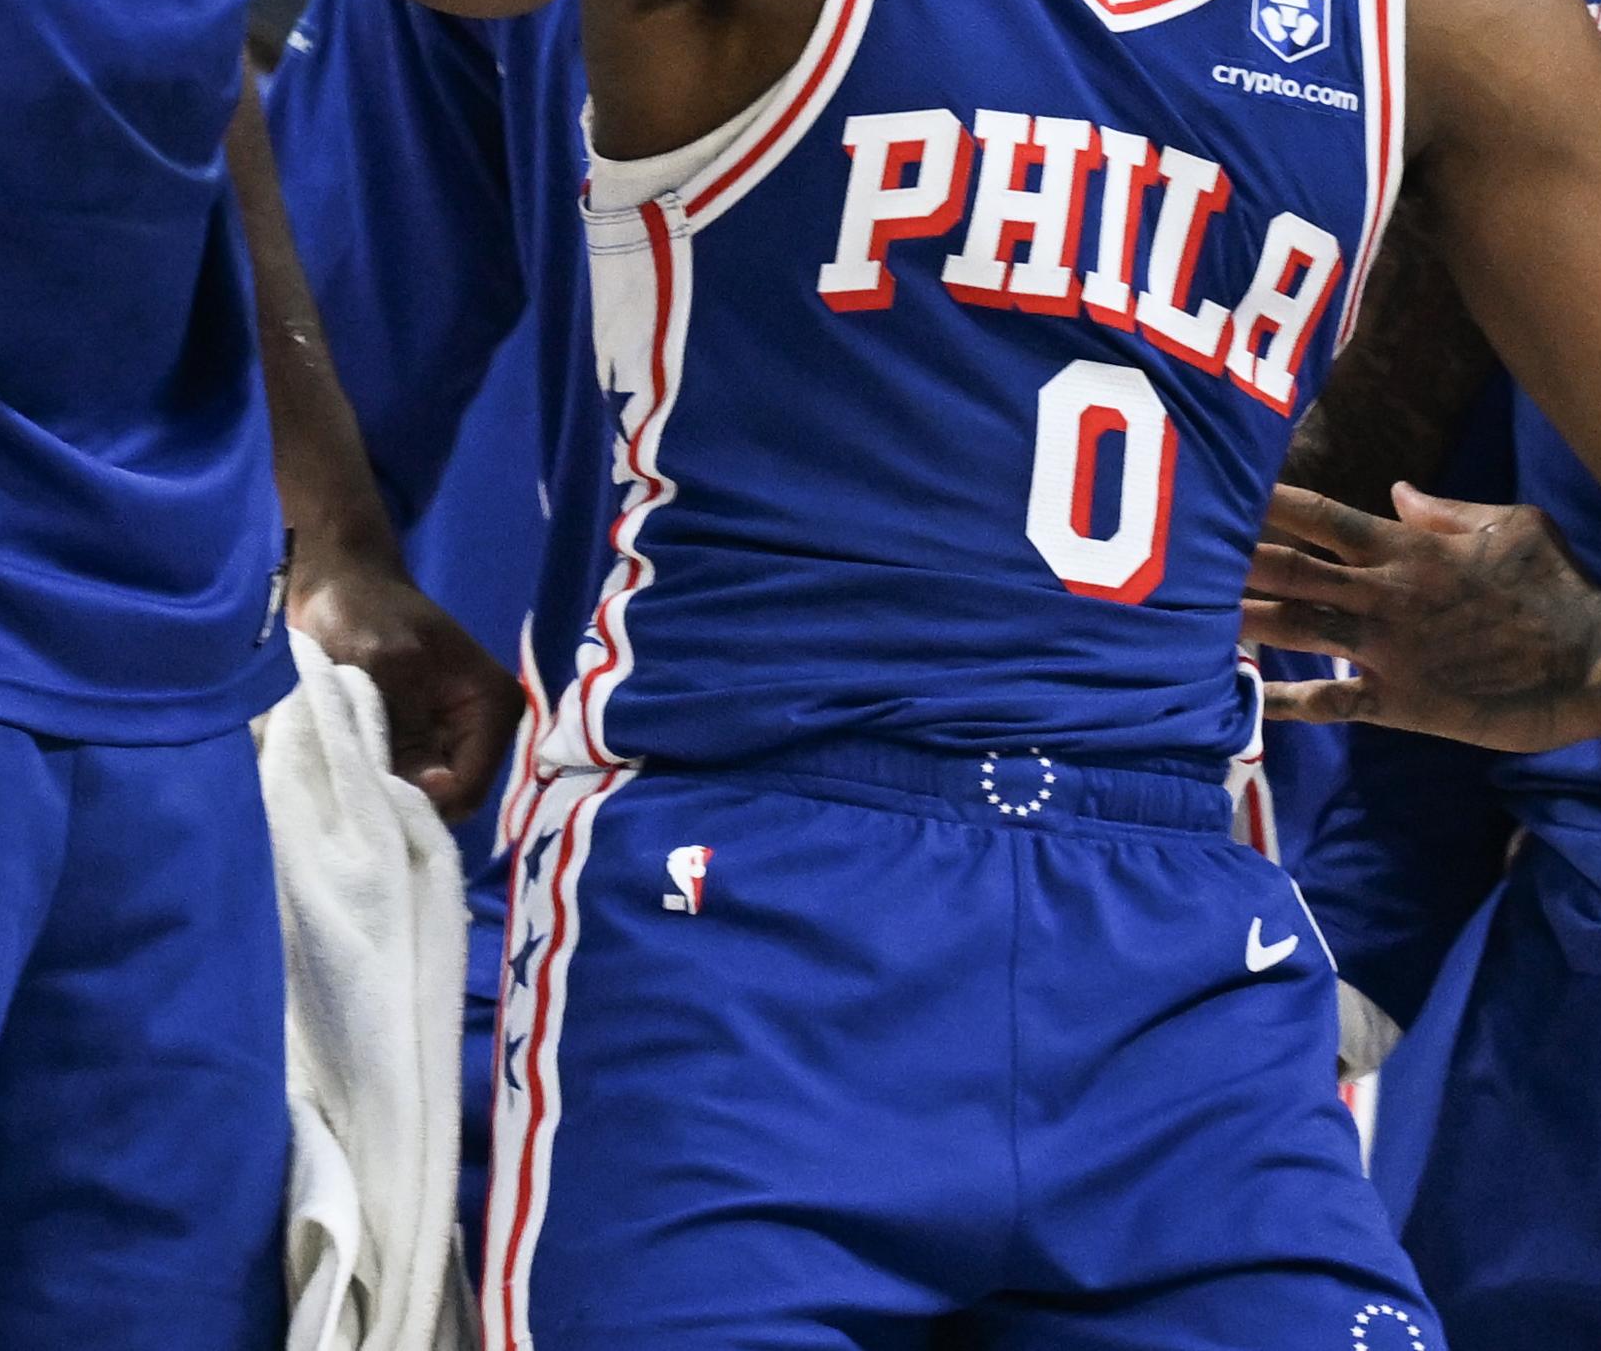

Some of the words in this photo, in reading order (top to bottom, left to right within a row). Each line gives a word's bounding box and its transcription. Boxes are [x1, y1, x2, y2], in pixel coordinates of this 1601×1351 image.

[1212, 63, 1359, 112] crypto.com
[816, 108, 1344, 418] PHILA
[1024, 359, 1179, 605] 0
